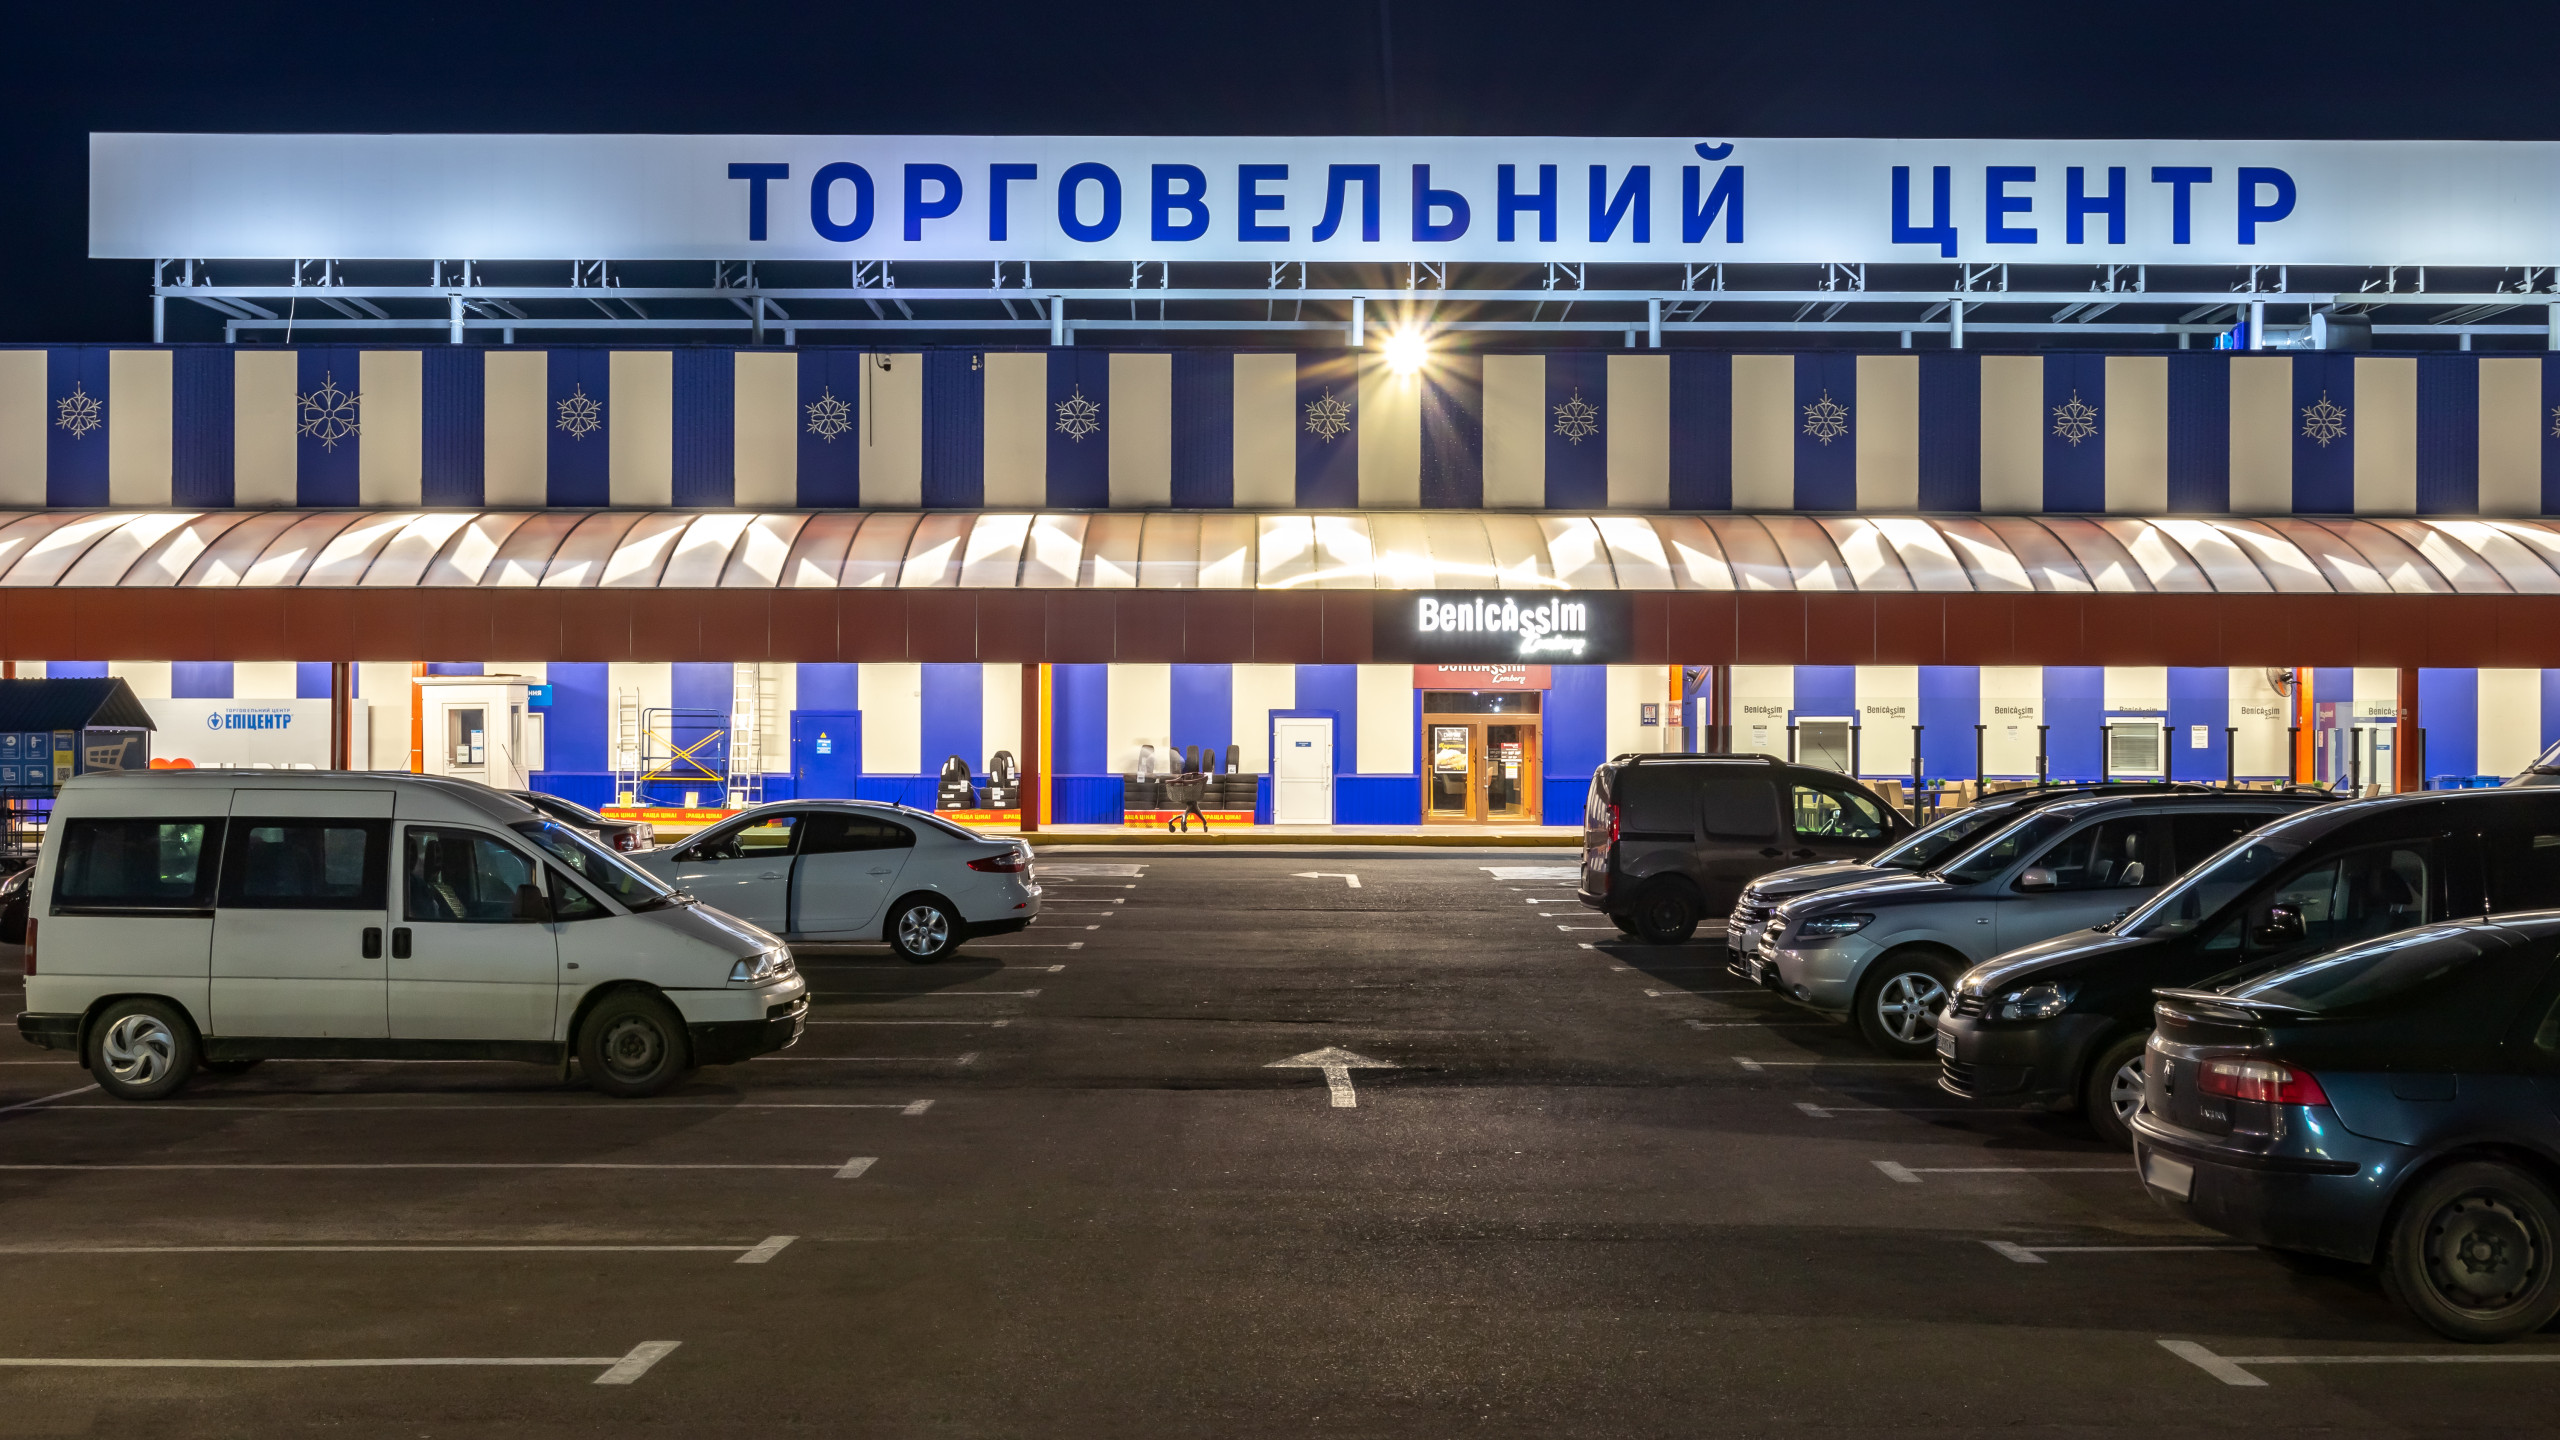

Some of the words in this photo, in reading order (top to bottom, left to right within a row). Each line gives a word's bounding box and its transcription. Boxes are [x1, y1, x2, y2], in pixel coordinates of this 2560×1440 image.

[727, 141, 1745, 244] ТОРГОВЕЛЬНИЙ
[1891, 163, 2297, 258] ЦЕНТР
[1492, 673, 1526, 684] Lemberg
[225, 713, 292, 730] ЕПІЦЕНТР
